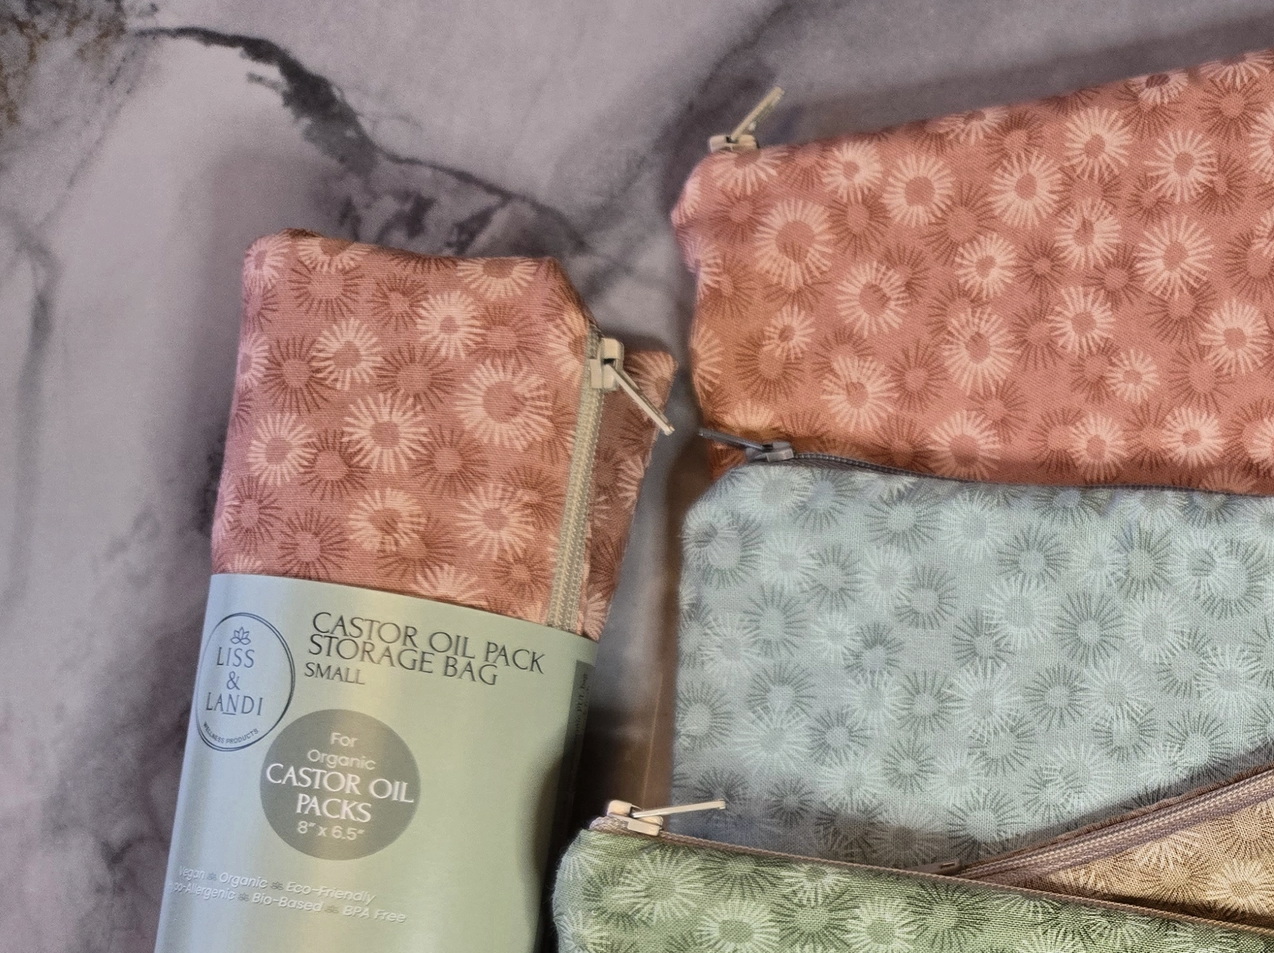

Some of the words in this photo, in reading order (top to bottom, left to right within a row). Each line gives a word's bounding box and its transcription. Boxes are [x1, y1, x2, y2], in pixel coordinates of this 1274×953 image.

[312, 611, 419, 648] CASTOR
[429, 631, 476, 659] OIL
[484, 641, 546, 674] PACK
[216, 647, 255, 669] LISS
[308, 634, 435, 674] STORAGE
[443, 655, 498, 685] BAG
[226, 671, 241, 690] &
[304, 662, 366, 685] SMALL
[205, 691, 264, 716] LANDI
[203, 721, 225, 744] WELLNESS
[225, 728, 259, 745] PRODUCTS
[330, 732, 358, 747] For
[307, 749, 376, 771] Organic
[266, 763, 362, 795] CASTOR
[368, 778, 415, 803] OIL
[296, 793, 372, 823] PACKS
[317, 826, 328, 837] x
[179, 866, 205, 881] Vegan
[219, 872, 268, 888] Organic
[286, 881, 376, 906] Eco-Friendly
[252, 892, 324, 912] Bio-Based
[342, 905, 370, 918] BPA
[374, 911, 406, 923] Free
